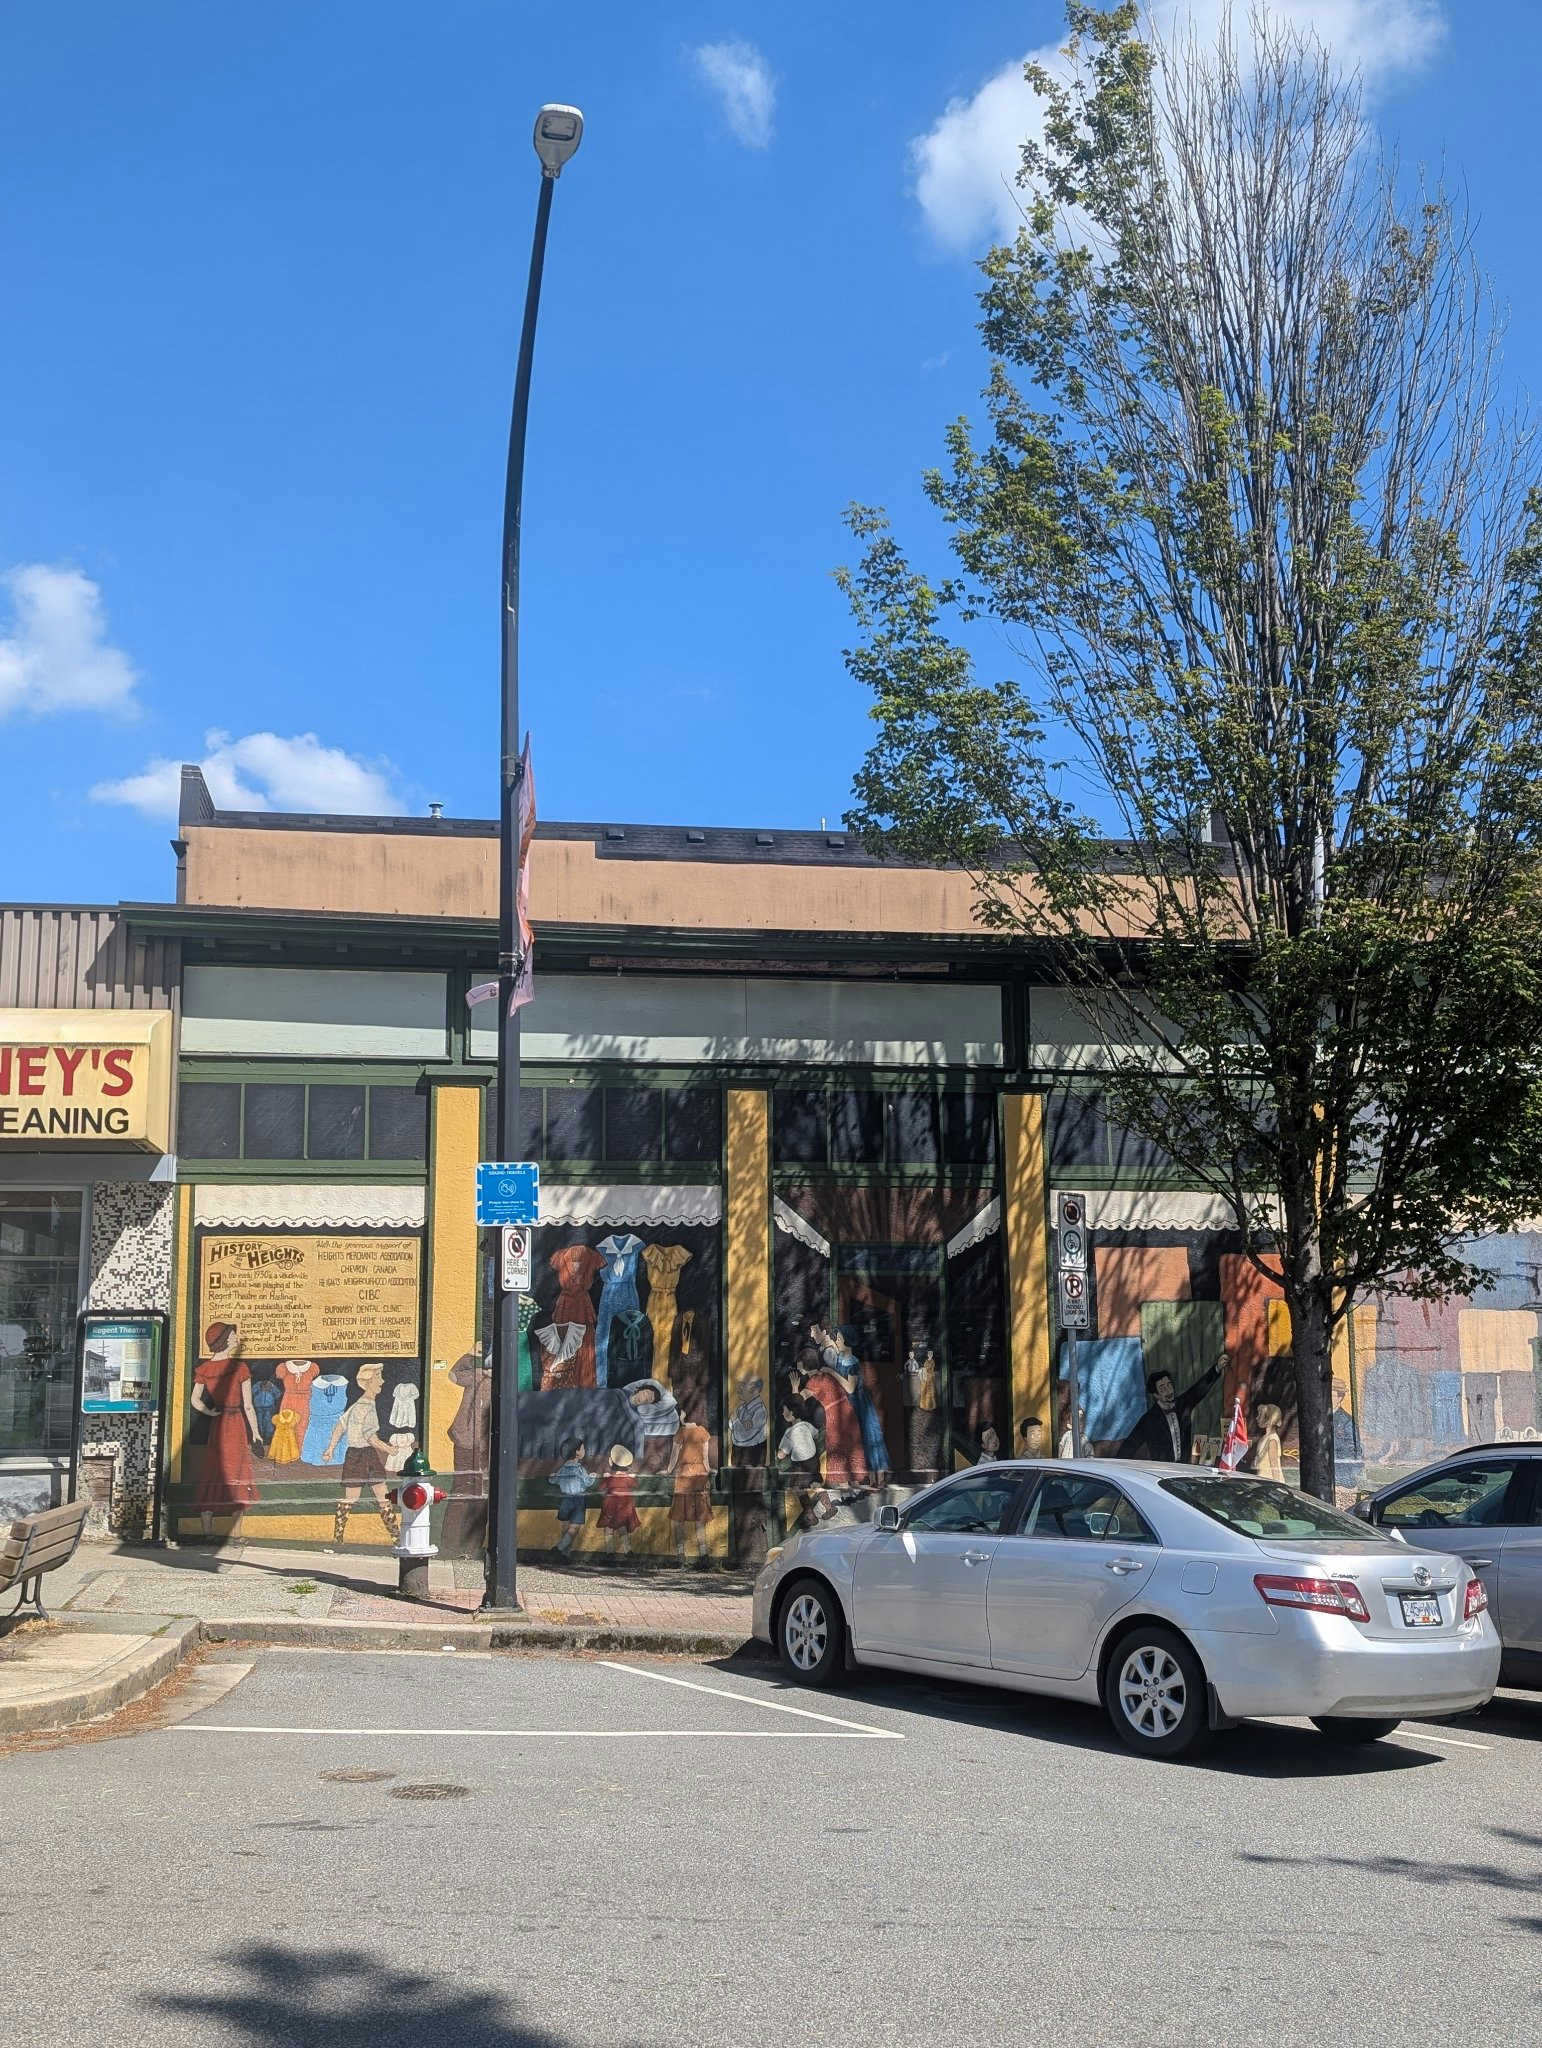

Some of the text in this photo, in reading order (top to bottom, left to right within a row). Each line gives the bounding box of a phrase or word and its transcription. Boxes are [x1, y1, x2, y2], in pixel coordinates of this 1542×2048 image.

[0, 1107, 129, 1134] EANING
[331, 1240, 343, 1248] the
[375, 1241, 403, 1250] support
[211, 1243, 262, 1262] HISTORY
[247, 1247, 305, 1269] HEIGHTS
[317, 1251, 414, 1261] HEIGHTS MERCHANTS ASSOCIATION
[506, 1258, 528, 1266] HERE TO
[340, 1265, 398, 1274] CHEVRON CANADA
[506, 1267, 528, 1275] CORNER
[262, 1281, 285, 1292] playing
[292, 1281, 304, 1289] the
[208, 1291, 233, 1303] Regent
[232, 1290, 258, 1300] Theatre
[269, 1291, 298, 1304] Hastings
[358, 1289, 381, 1300] CIBC
[254, 1302, 283, 1313] publicity
[324, 1304, 403, 1314] BURNABY DENTAL CLINIC
[209, 1311, 233, 1322] placed
[241, 1313, 264, 1322] young
[322, 1316, 413, 1326] ROBERTSON HOME HARDWARE
[240, 1318, 308, 1329] trance and she slept
[92, 1326, 147, 1335] Regent Theatre
[239, 1327, 271, 1337] overnight
[279, 1326, 291, 1334] the
[331, 1329, 401, 1341] CANADA SCAFFOLDING
[240, 1344, 253, 1354] Dry
[253, 1343, 276, 1352] Goods
